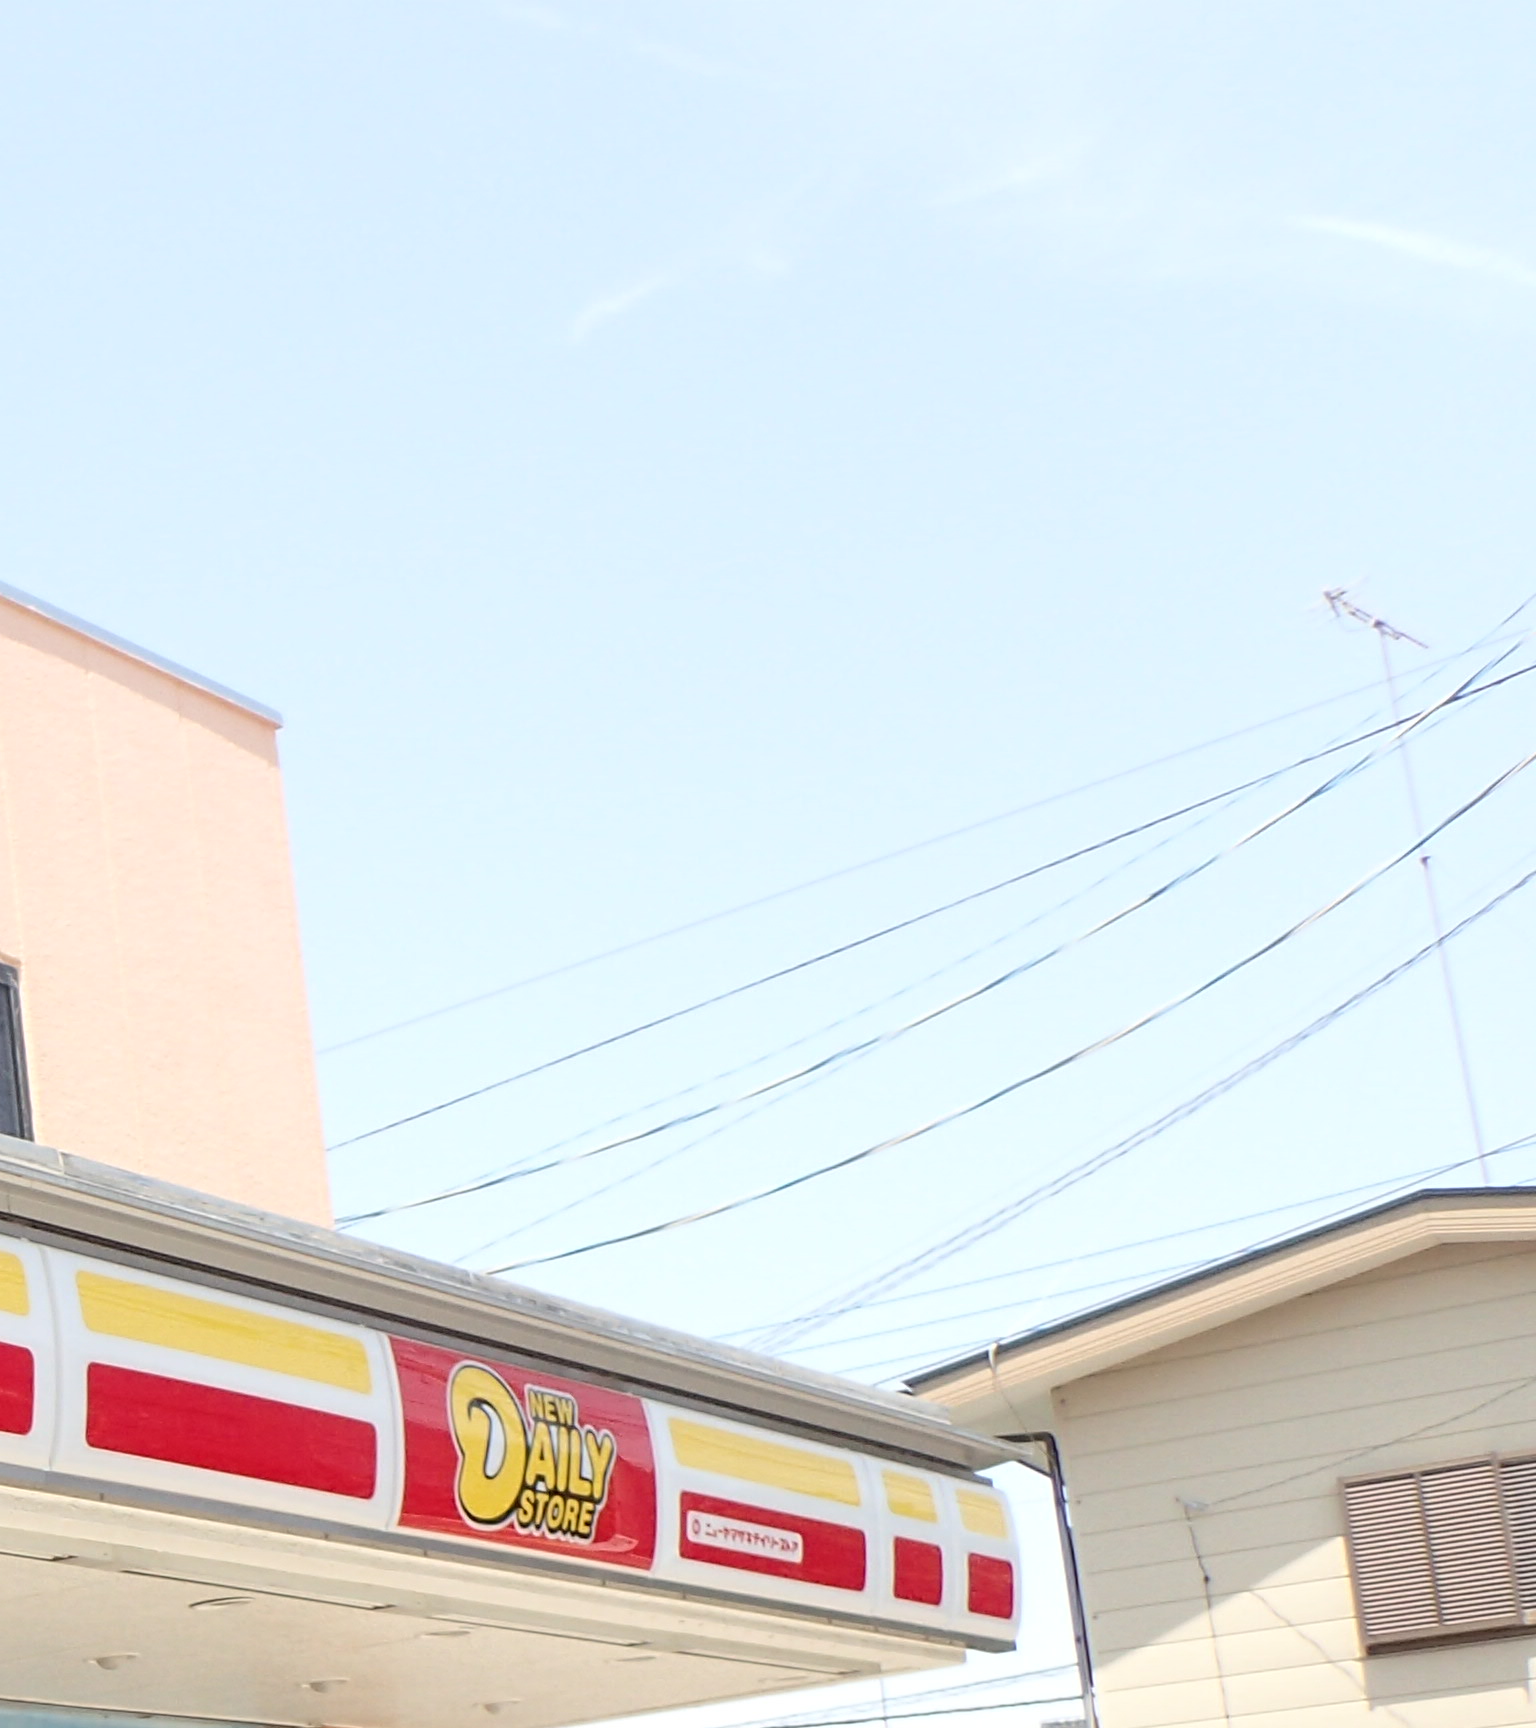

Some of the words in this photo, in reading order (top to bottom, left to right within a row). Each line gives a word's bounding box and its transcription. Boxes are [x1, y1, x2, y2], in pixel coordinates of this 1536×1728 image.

[528, 1391, 574, 1425] NEW
[449, 1364, 614, 1526] DAILY
[517, 1489, 596, 1538] STORE
